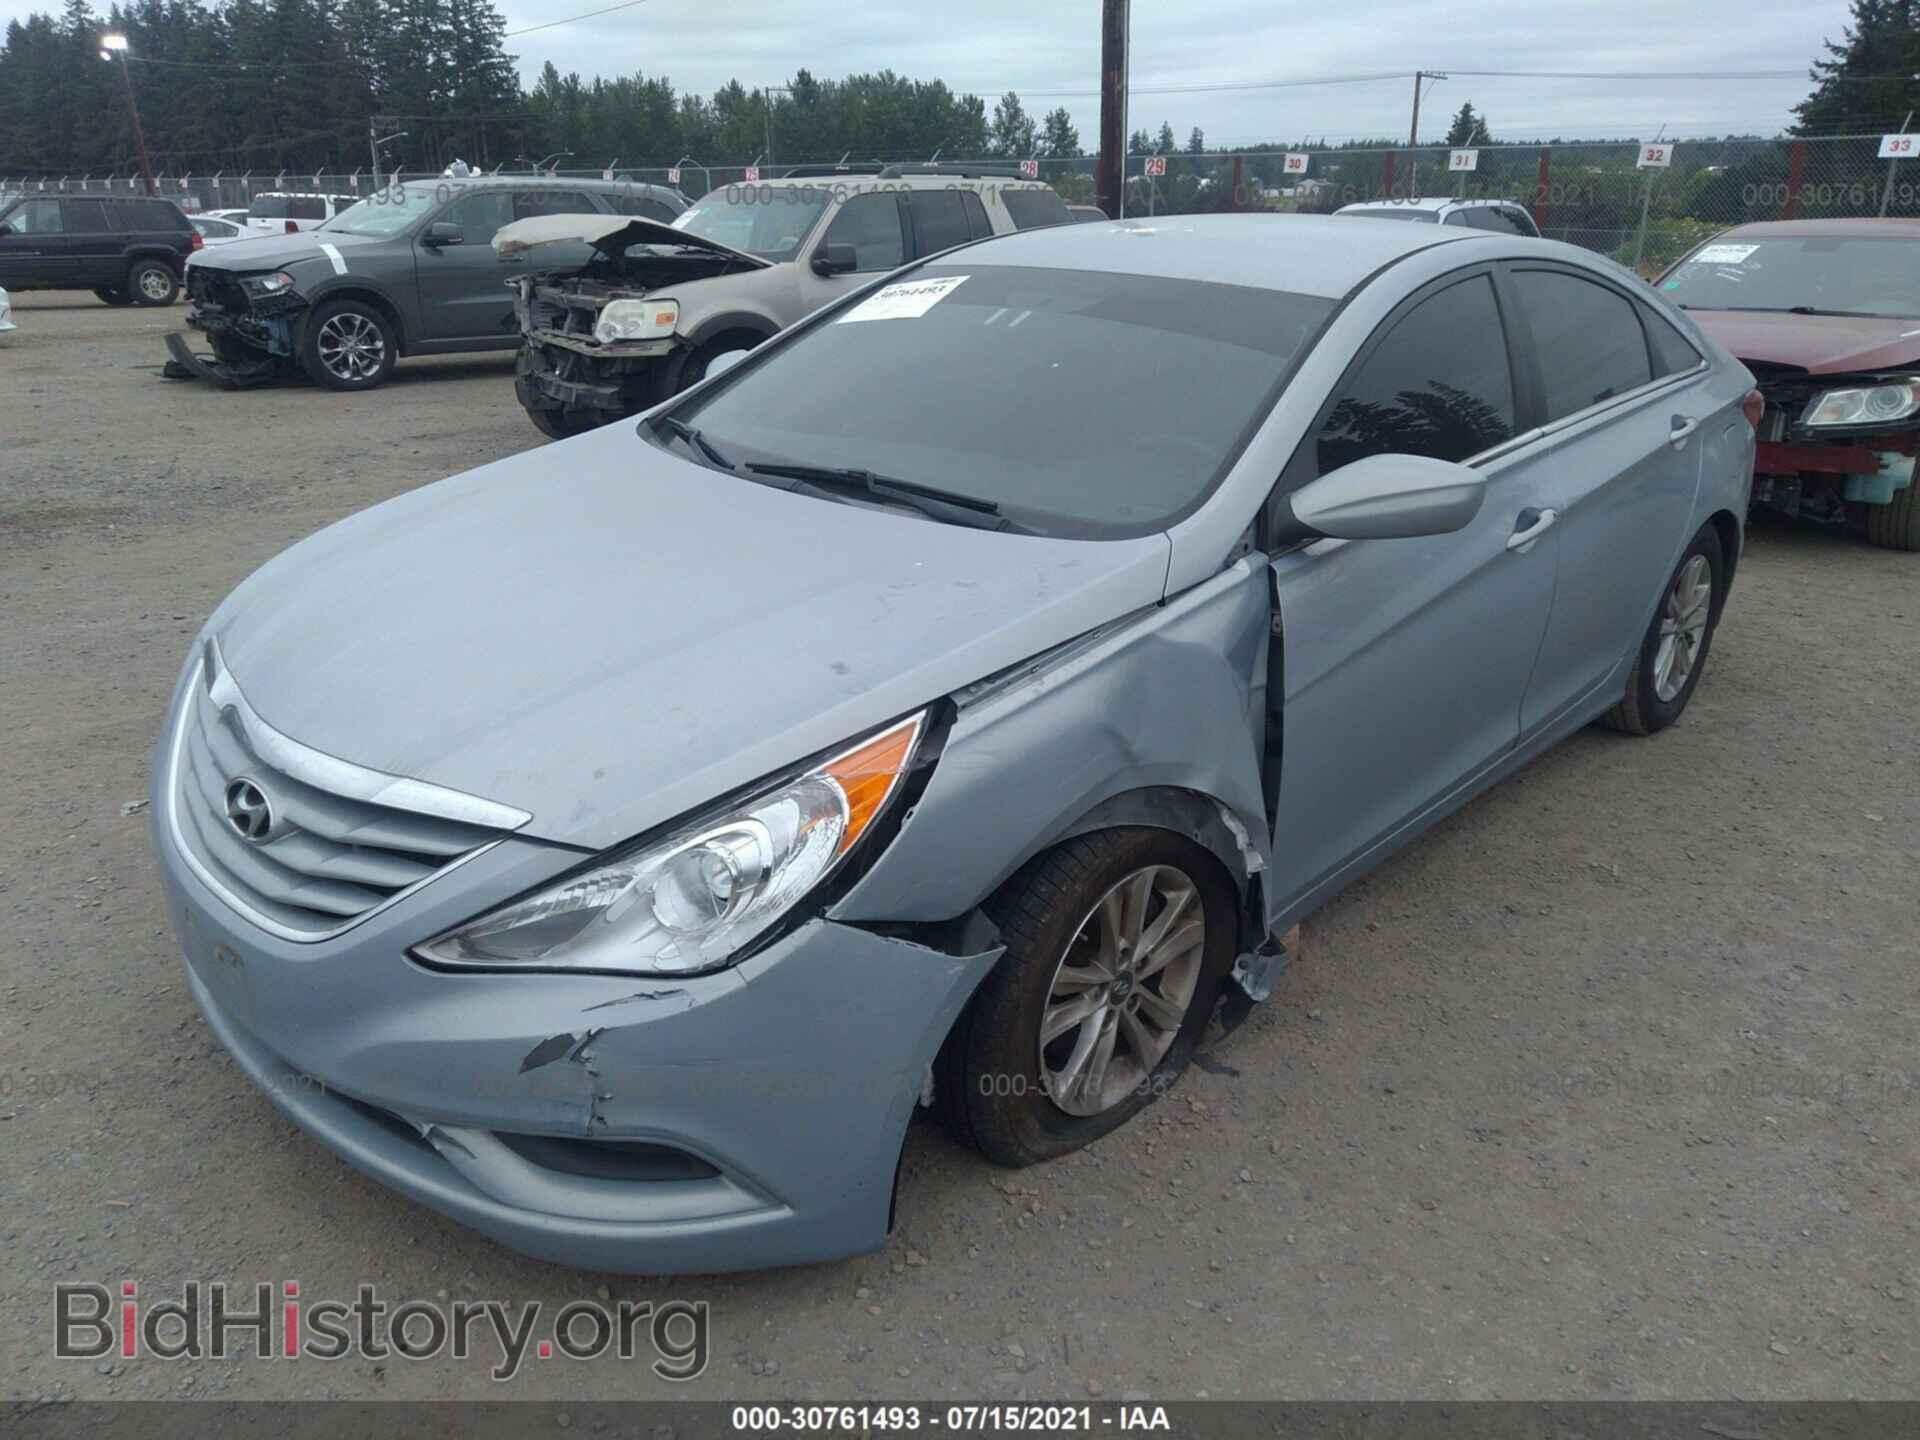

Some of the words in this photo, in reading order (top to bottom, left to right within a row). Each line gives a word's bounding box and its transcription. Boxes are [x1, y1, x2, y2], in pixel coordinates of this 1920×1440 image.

[1889, 139, 1911, 152] 33
[1455, 154, 1471, 167] 31
[1645, 149, 1664, 162] 32
[1146, 158, 1165, 175] 29
[1287, 158, 1301, 169] 30
